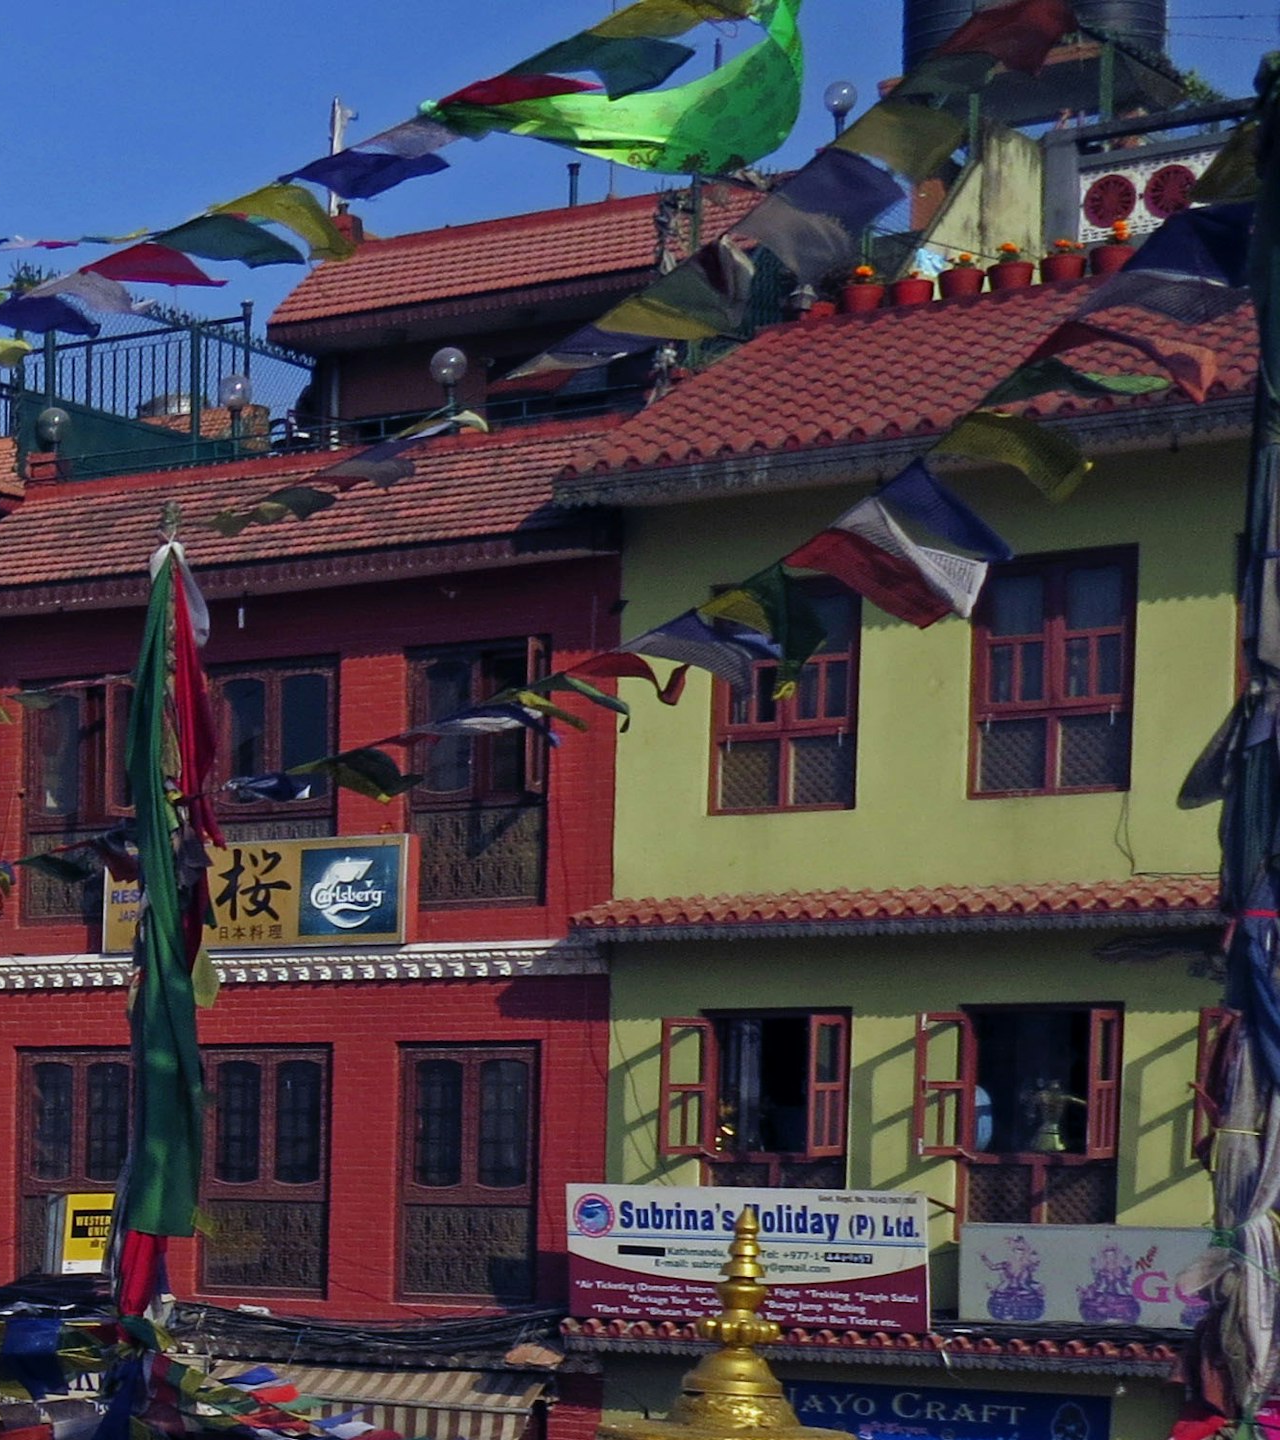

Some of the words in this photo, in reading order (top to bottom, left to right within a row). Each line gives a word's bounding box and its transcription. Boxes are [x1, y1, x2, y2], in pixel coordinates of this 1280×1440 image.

[215, 848, 292, 922] 桜
[309, 879, 386, 911] Carlsberg
[218, 924, 283, 942] 日本料理
[75, 1215, 112, 1227] WESTER
[619, 1200, 735, 1232] Subrina's
[848, 1214, 876, 1240] (P)
[882, 1215, 920, 1238] Ltd.
[667, 1247, 727, 1258] Kathmandu,
[595, 1280, 636, 1293] Ticketing
[774, 1288, 801, 1299] Flight
[890, 1293, 919, 1303] Safari
[669, 1295, 691, 1305] Tour
[621, 1304, 642, 1314] Tour
[684, 1307, 705, 1317] Tour
[765, 1311, 786, 1322] Tour
[828, 1314, 847, 1324] Bus
[848, 1315, 879, 1327] Ticket
